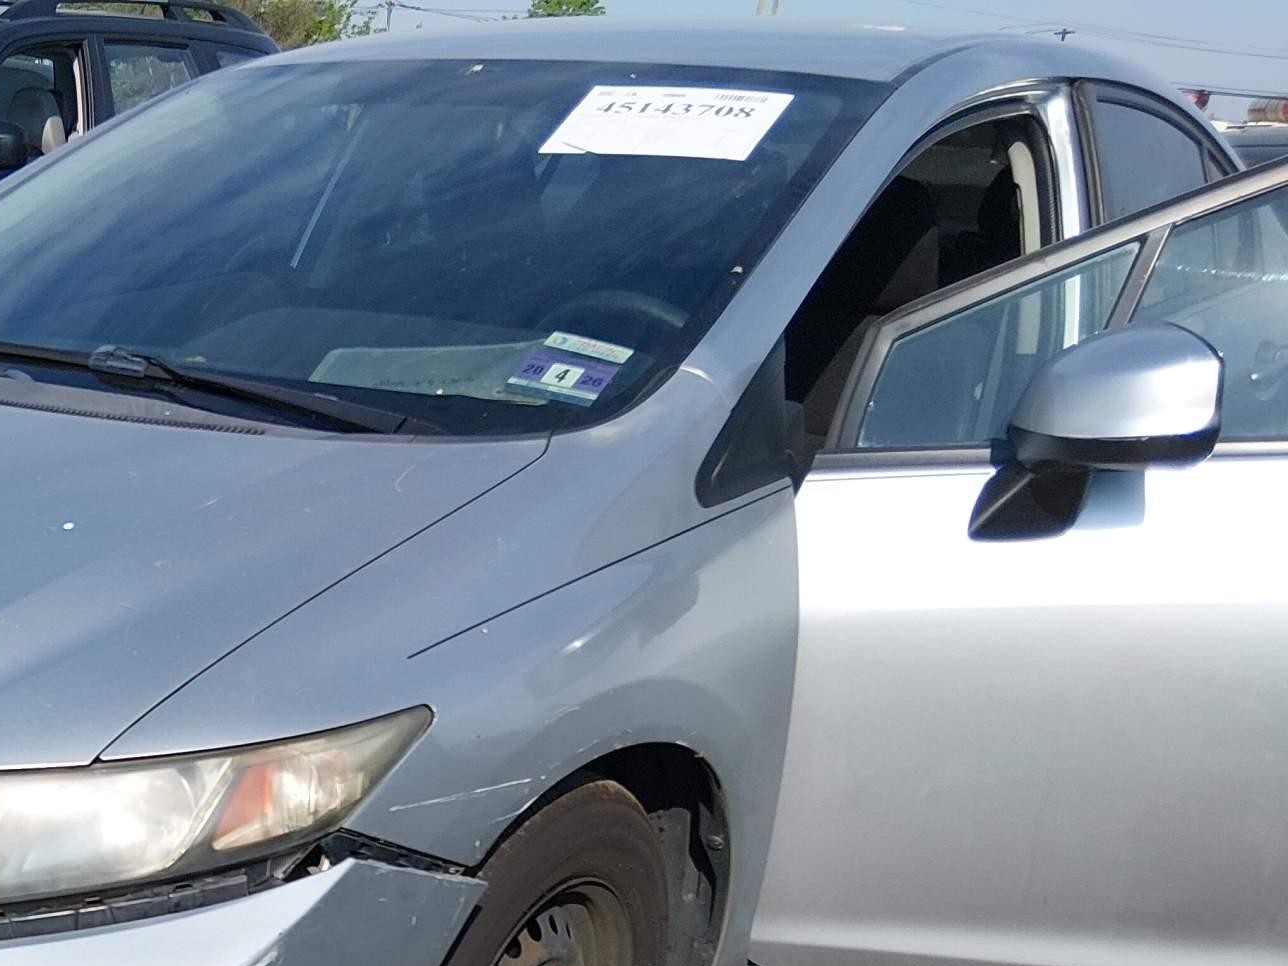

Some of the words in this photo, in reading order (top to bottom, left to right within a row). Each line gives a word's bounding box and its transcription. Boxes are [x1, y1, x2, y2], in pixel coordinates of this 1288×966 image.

[596, 102, 755, 118] 45143708
[522, 363, 545, 376] 20
[555, 368, 570, 383] 4
[579, 375, 603, 388] 26
